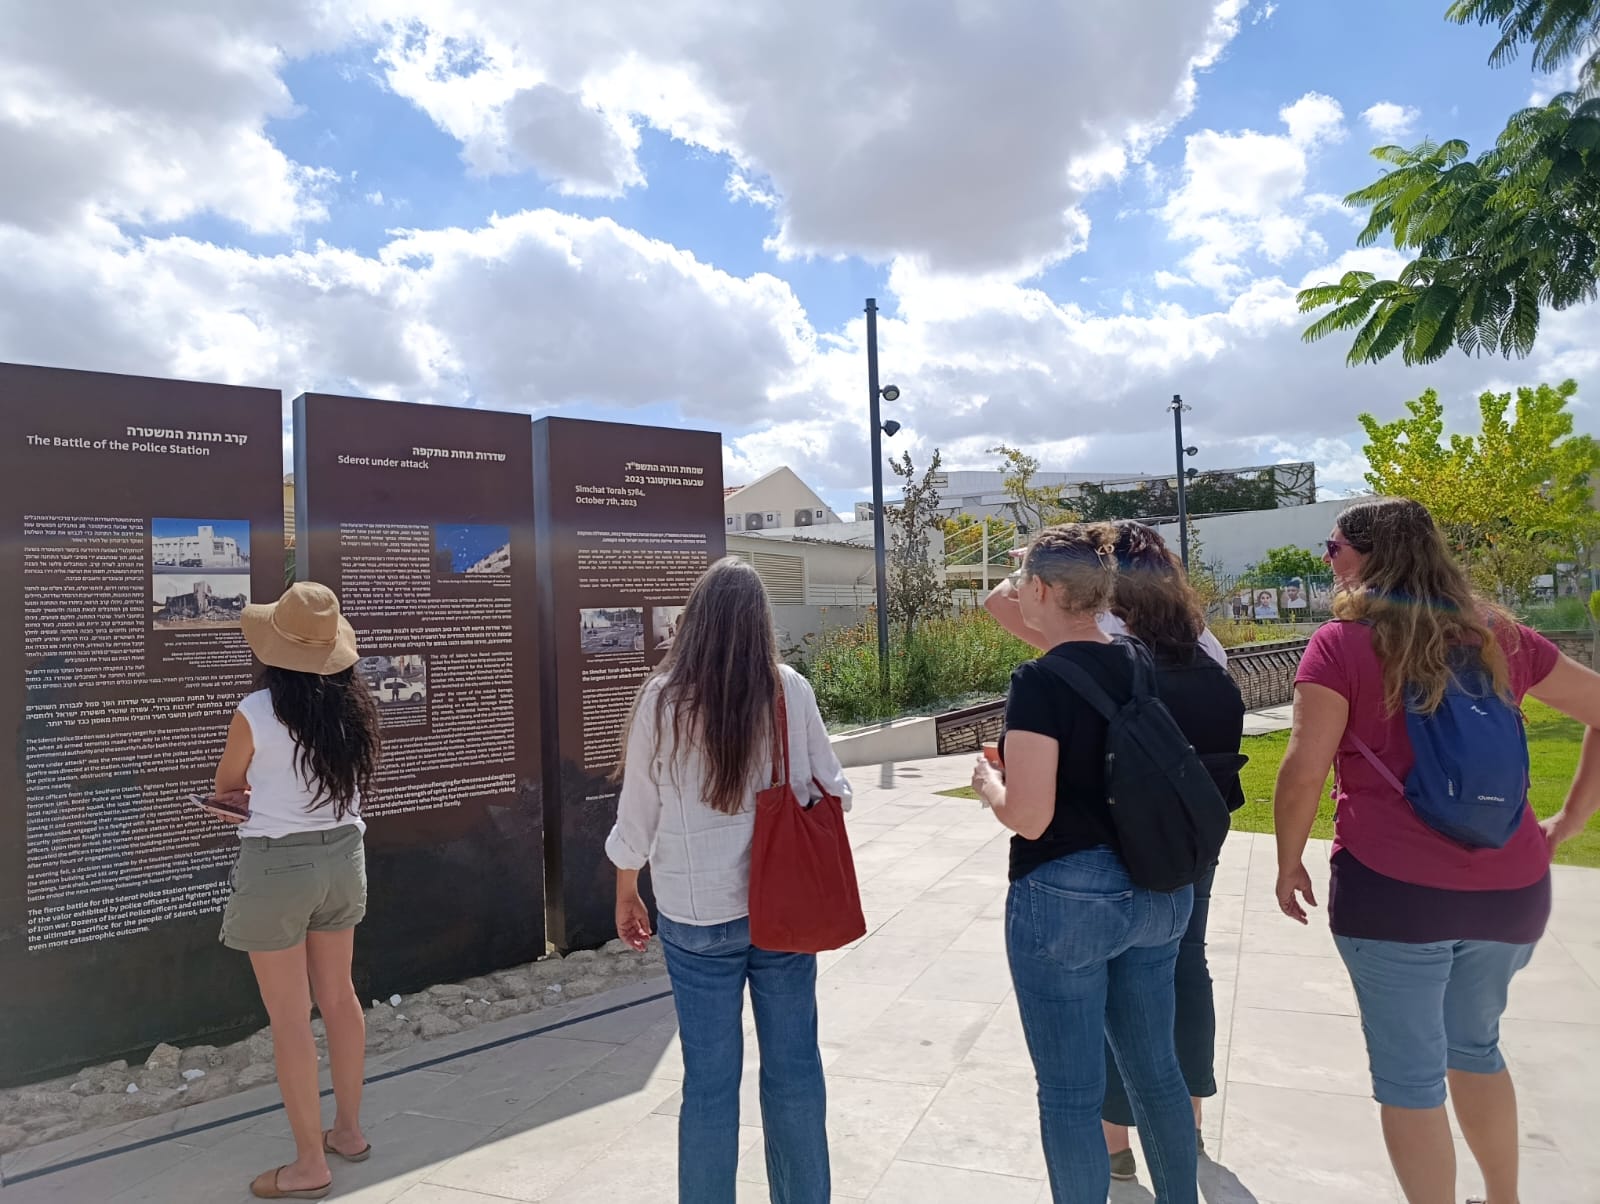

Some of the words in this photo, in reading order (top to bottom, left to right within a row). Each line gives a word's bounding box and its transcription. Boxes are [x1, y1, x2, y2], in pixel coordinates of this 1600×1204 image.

[127, 427, 183, 439] המשטרה
[187, 431, 222, 442] תחנת
[27, 435, 50, 445] The
[54, 437, 90, 448] Battle
[94, 439, 106, 449] of
[110, 440, 128, 450] the
[132, 442, 167, 453] Police
[170, 445, 209, 455] Station
[225, 434, 247, 445] קרב
[413, 447, 448, 458] מתקפה
[451, 450, 473, 459] תחת
[476, 452, 506, 461] שדרות
[338, 455, 369, 465] Sderot
[372, 458, 398, 467] under
[401, 460, 428, 469] attack
[625, 475, 644, 484] 2023
[646, 476, 681, 486] באוקטובר
[576, 485, 604, 494] Simchat
[576, 496, 604, 504] October
[606, 497, 619, 506] 7th,
[67, 902, 88, 910] battle
[115, 894, 138, 902] Sderot
[162, 887, 186, 895] Station
[188, 882, 217, 891] emerged
[74, 906, 108, 917] exhibited
[120, 902, 142, 912] police
[143, 898, 169, 906] officers
[186, 891, 211, 901] fighters
[72, 918, 98, 927] Dozens
[108, 912, 128, 921] Israel
[152, 905, 177, 913] officers
[44, 930, 76, 940] ultimate
[78, 925, 108, 934] sacrifice
[138, 915, 162, 925] people
[174, 909, 197, 918] Sderot,
[200, 905, 221, 914] saving
[70, 931, 115, 944] catastrophic
